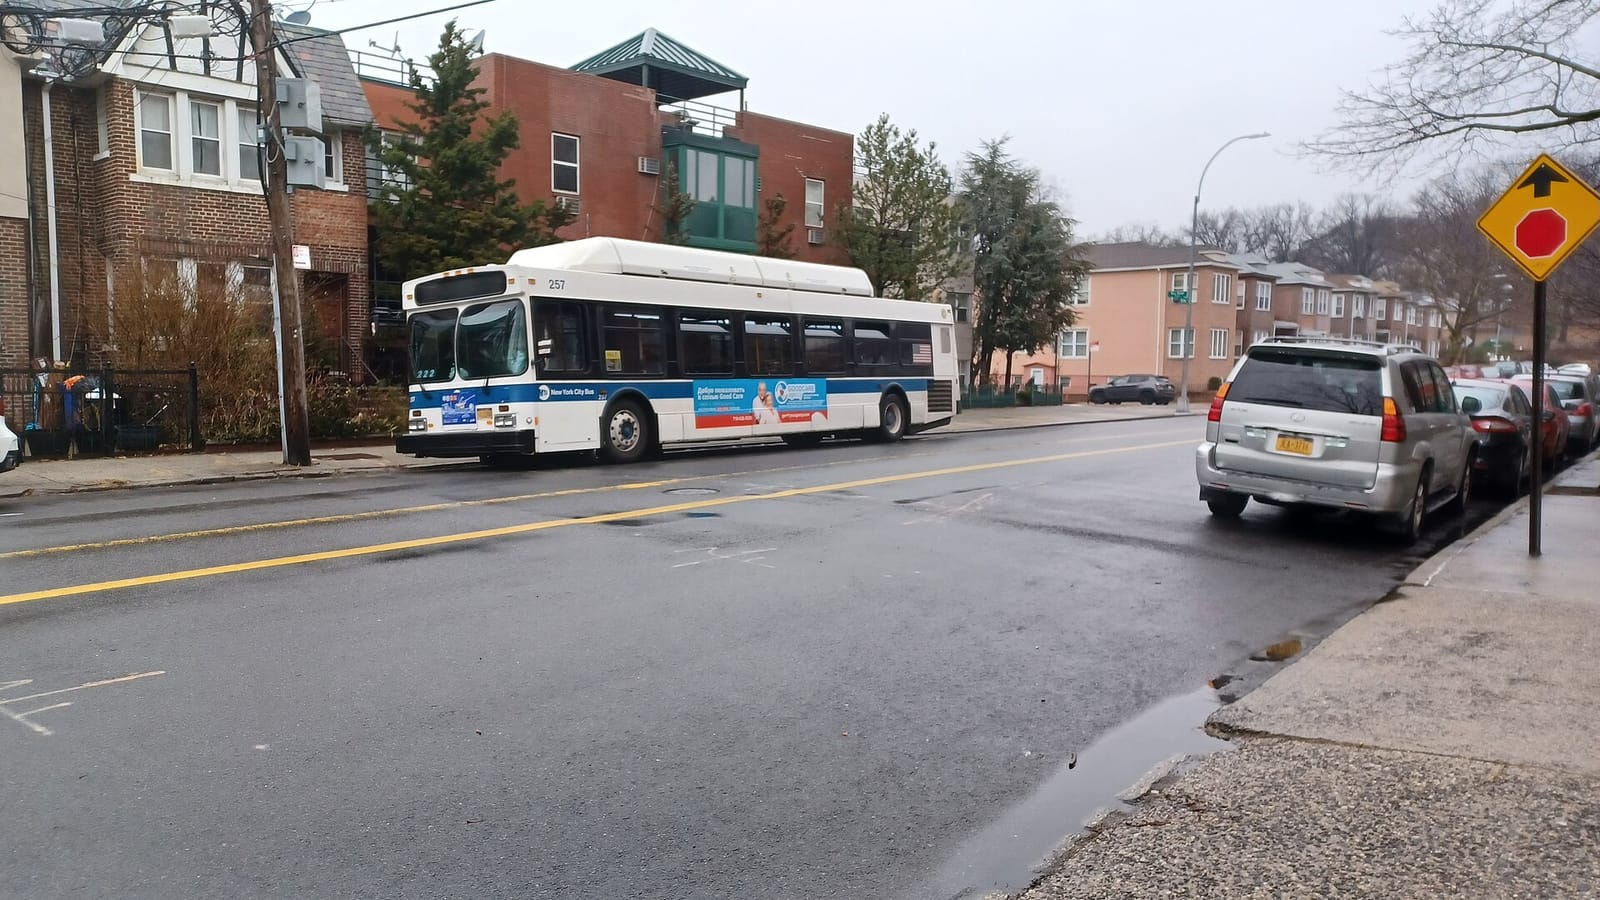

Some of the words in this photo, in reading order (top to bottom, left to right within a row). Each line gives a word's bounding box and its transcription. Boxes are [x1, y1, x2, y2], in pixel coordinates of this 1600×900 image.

[548, 279, 566, 290] 257
[416, 369, 435, 379] 222
[550, 388, 562, 396] New
[562, 388, 574, 396] York
[574, 388, 584, 397] City
[584, 388, 595, 396] Bus
